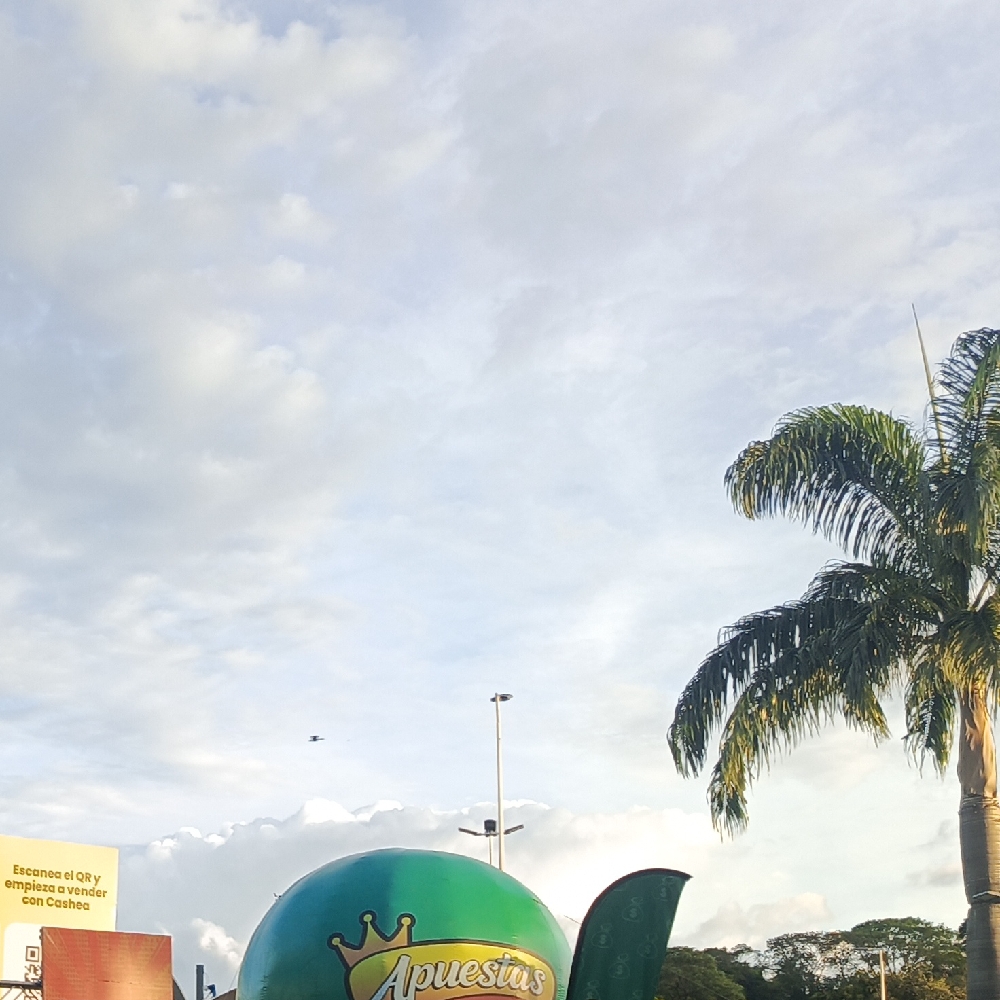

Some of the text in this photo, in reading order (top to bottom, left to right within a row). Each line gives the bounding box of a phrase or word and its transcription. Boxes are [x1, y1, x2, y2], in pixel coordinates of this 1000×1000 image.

[13, 864, 102, 887] Escanea el QR y
[4, 879, 108, 899] empieza a vender
[22, 896, 90, 911] con Cashea
